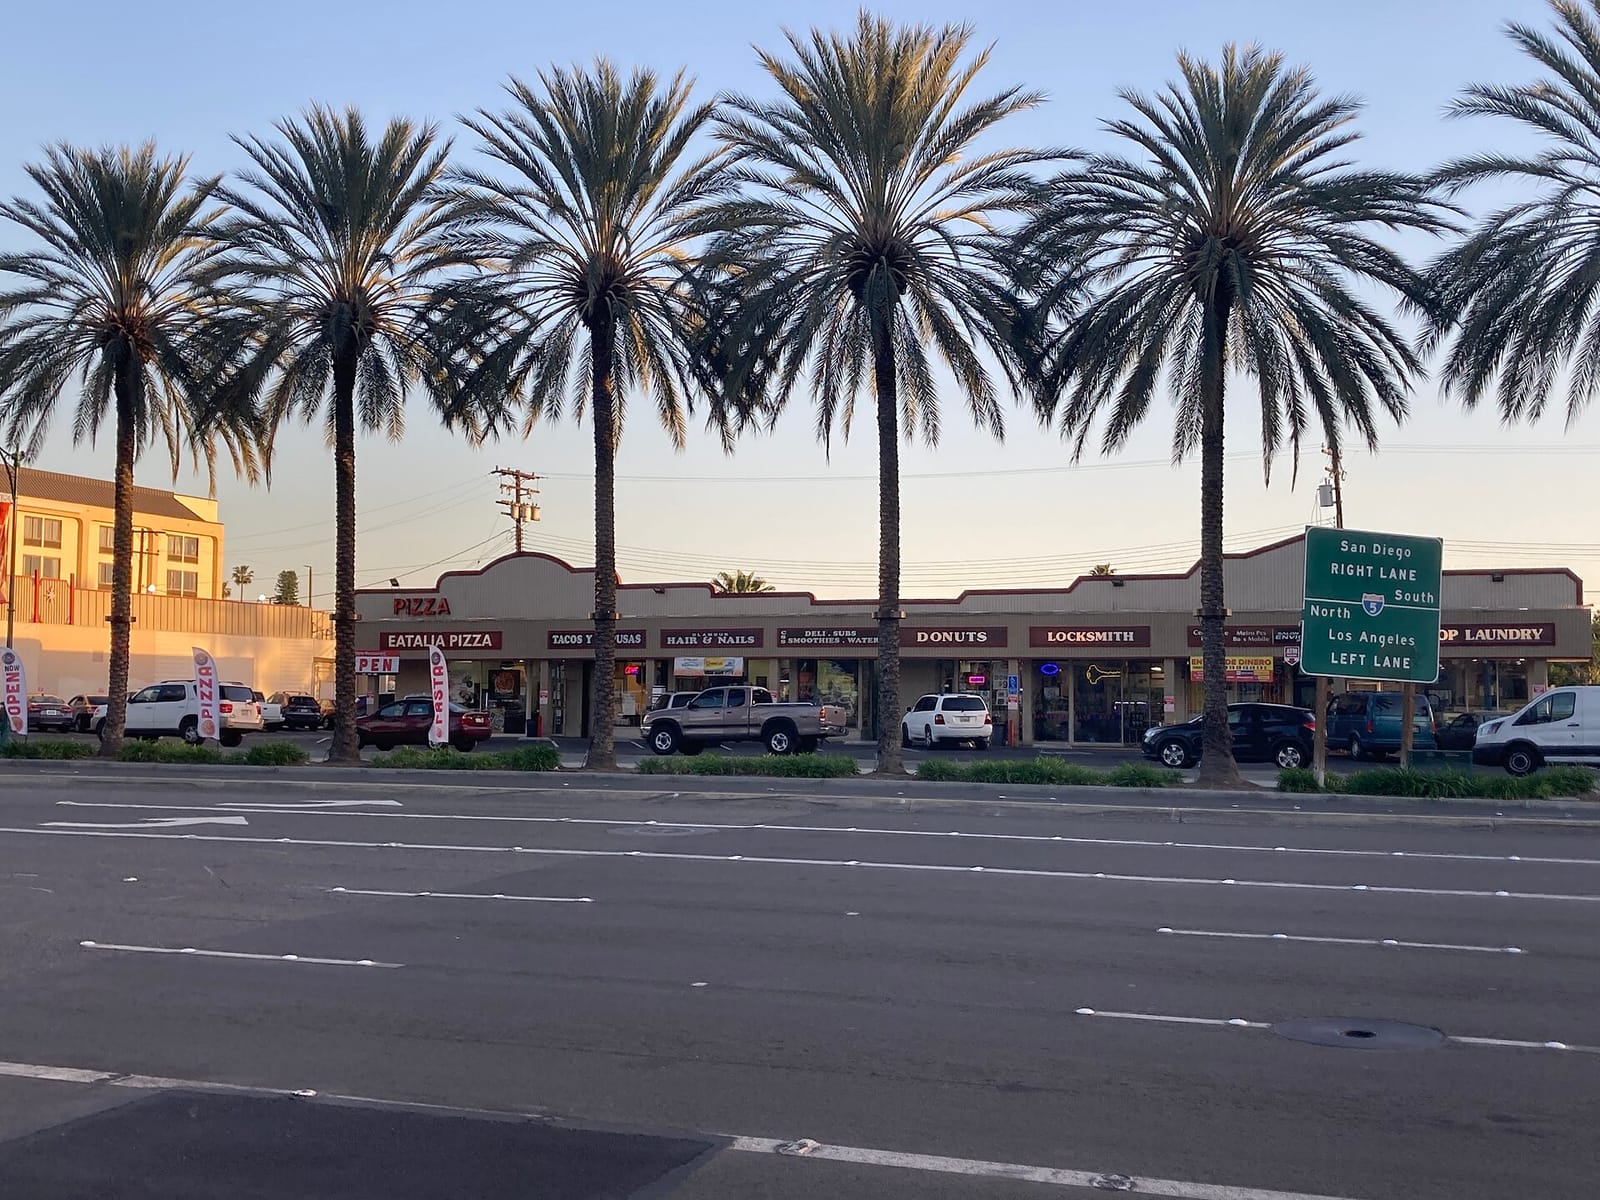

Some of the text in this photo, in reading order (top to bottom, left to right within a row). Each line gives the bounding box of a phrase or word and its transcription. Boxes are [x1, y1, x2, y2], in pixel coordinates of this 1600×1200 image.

[1340, 540, 1411, 560] San Diego
[1331, 562, 1417, 581] RIGHT LANE
[1394, 589, 1434, 604] South
[393, 597, 451, 616] PIZZA
[1310, 605, 1350, 619] North
[1369, 602, 1377, 614] 5
[388, 633, 492, 648] EATALIA PIZZA
[552, 633, 642, 644] TACOS Y USAS
[667, 636, 755, 645] HAIR & NAILS
[916, 631, 988, 642] DONUTS
[1047, 631, 1134, 642] LOCKSMITH
[1328, 628, 1415, 647] Los Angeles
[1464, 628, 1543, 641] LAUNDRY
[358, 658, 393, 672] PEN
[1238, 658, 1271, 666] DINERO
[1331, 652, 1410, 669] LEFT LANE
[4, 664, 20, 672] NOW
[6, 672, 21, 716] OPEN
[198, 666, 213, 719] PIZZA
